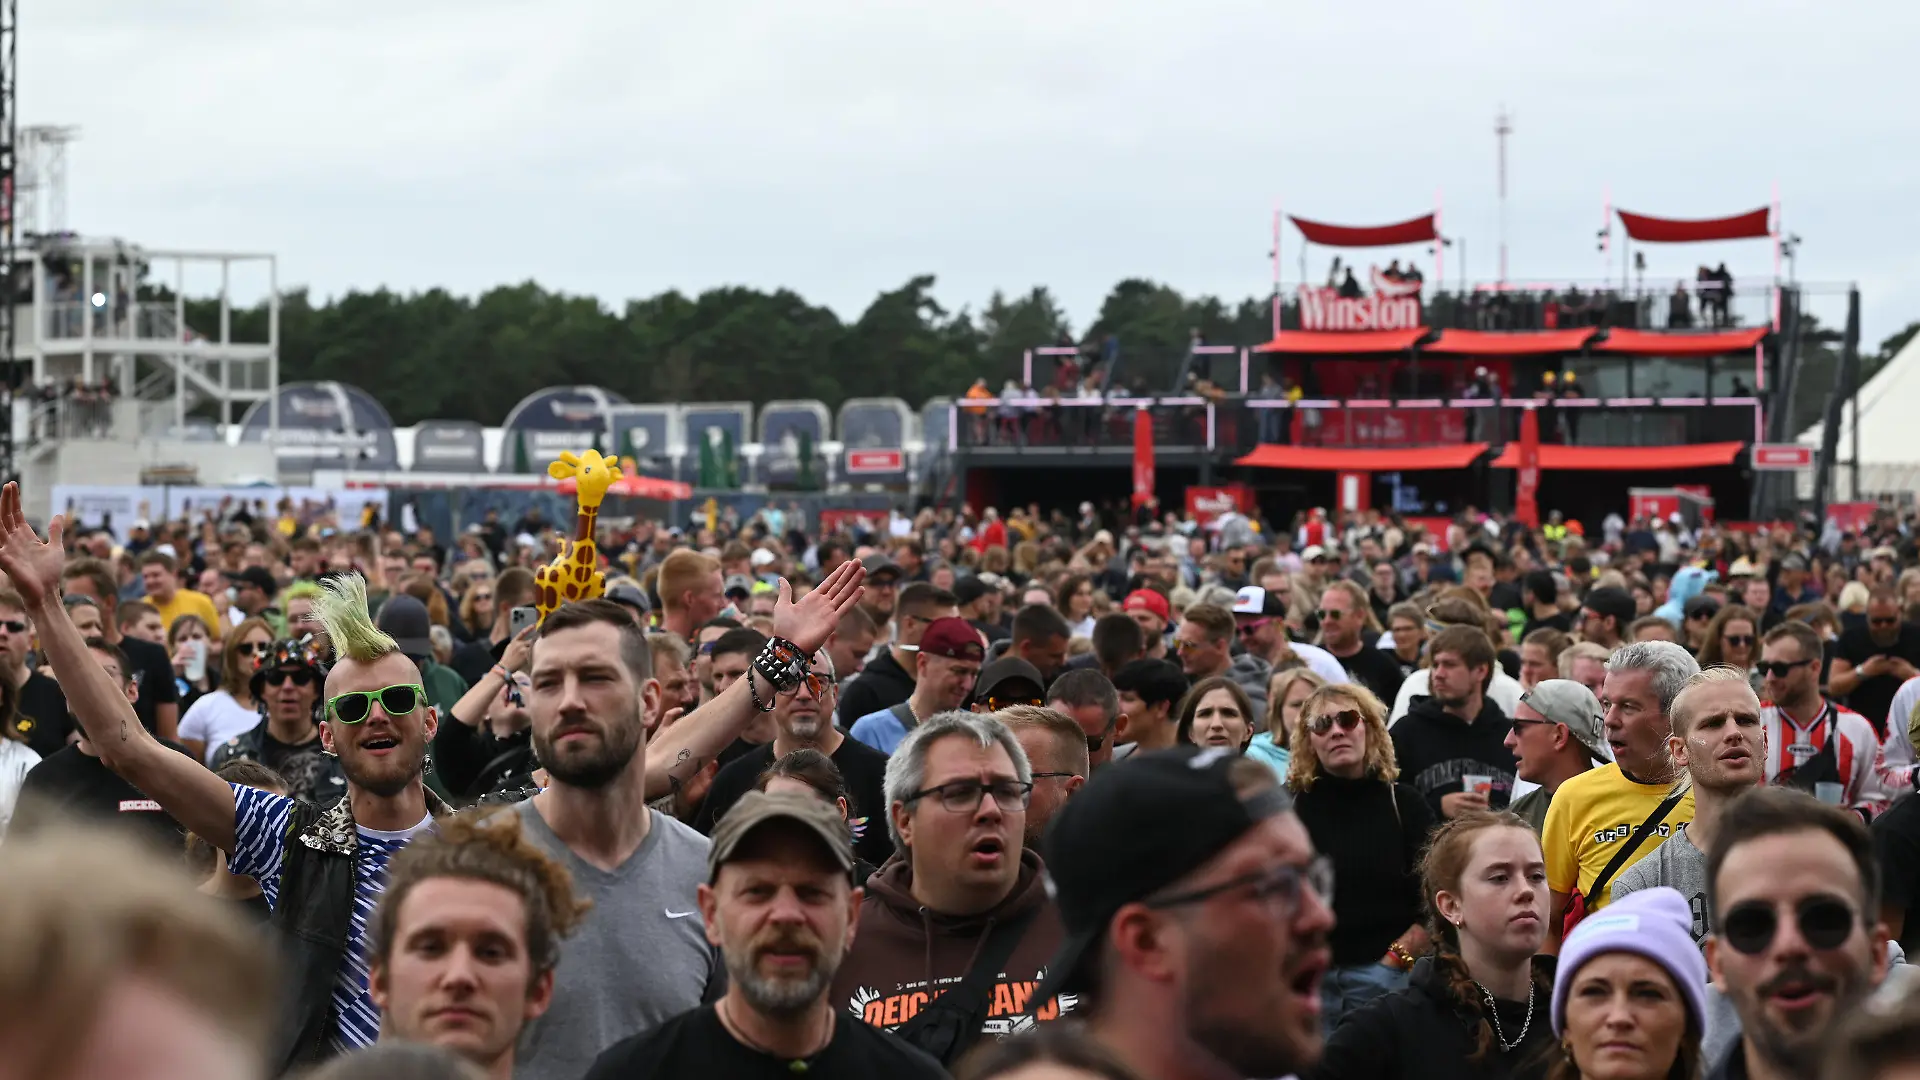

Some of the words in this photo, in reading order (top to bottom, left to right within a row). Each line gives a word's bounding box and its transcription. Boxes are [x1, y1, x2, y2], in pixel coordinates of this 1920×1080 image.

[1298, 283, 1419, 331] Winston
[1594, 824, 1630, 844] THE
[864, 981, 1060, 1028] DEICAN
